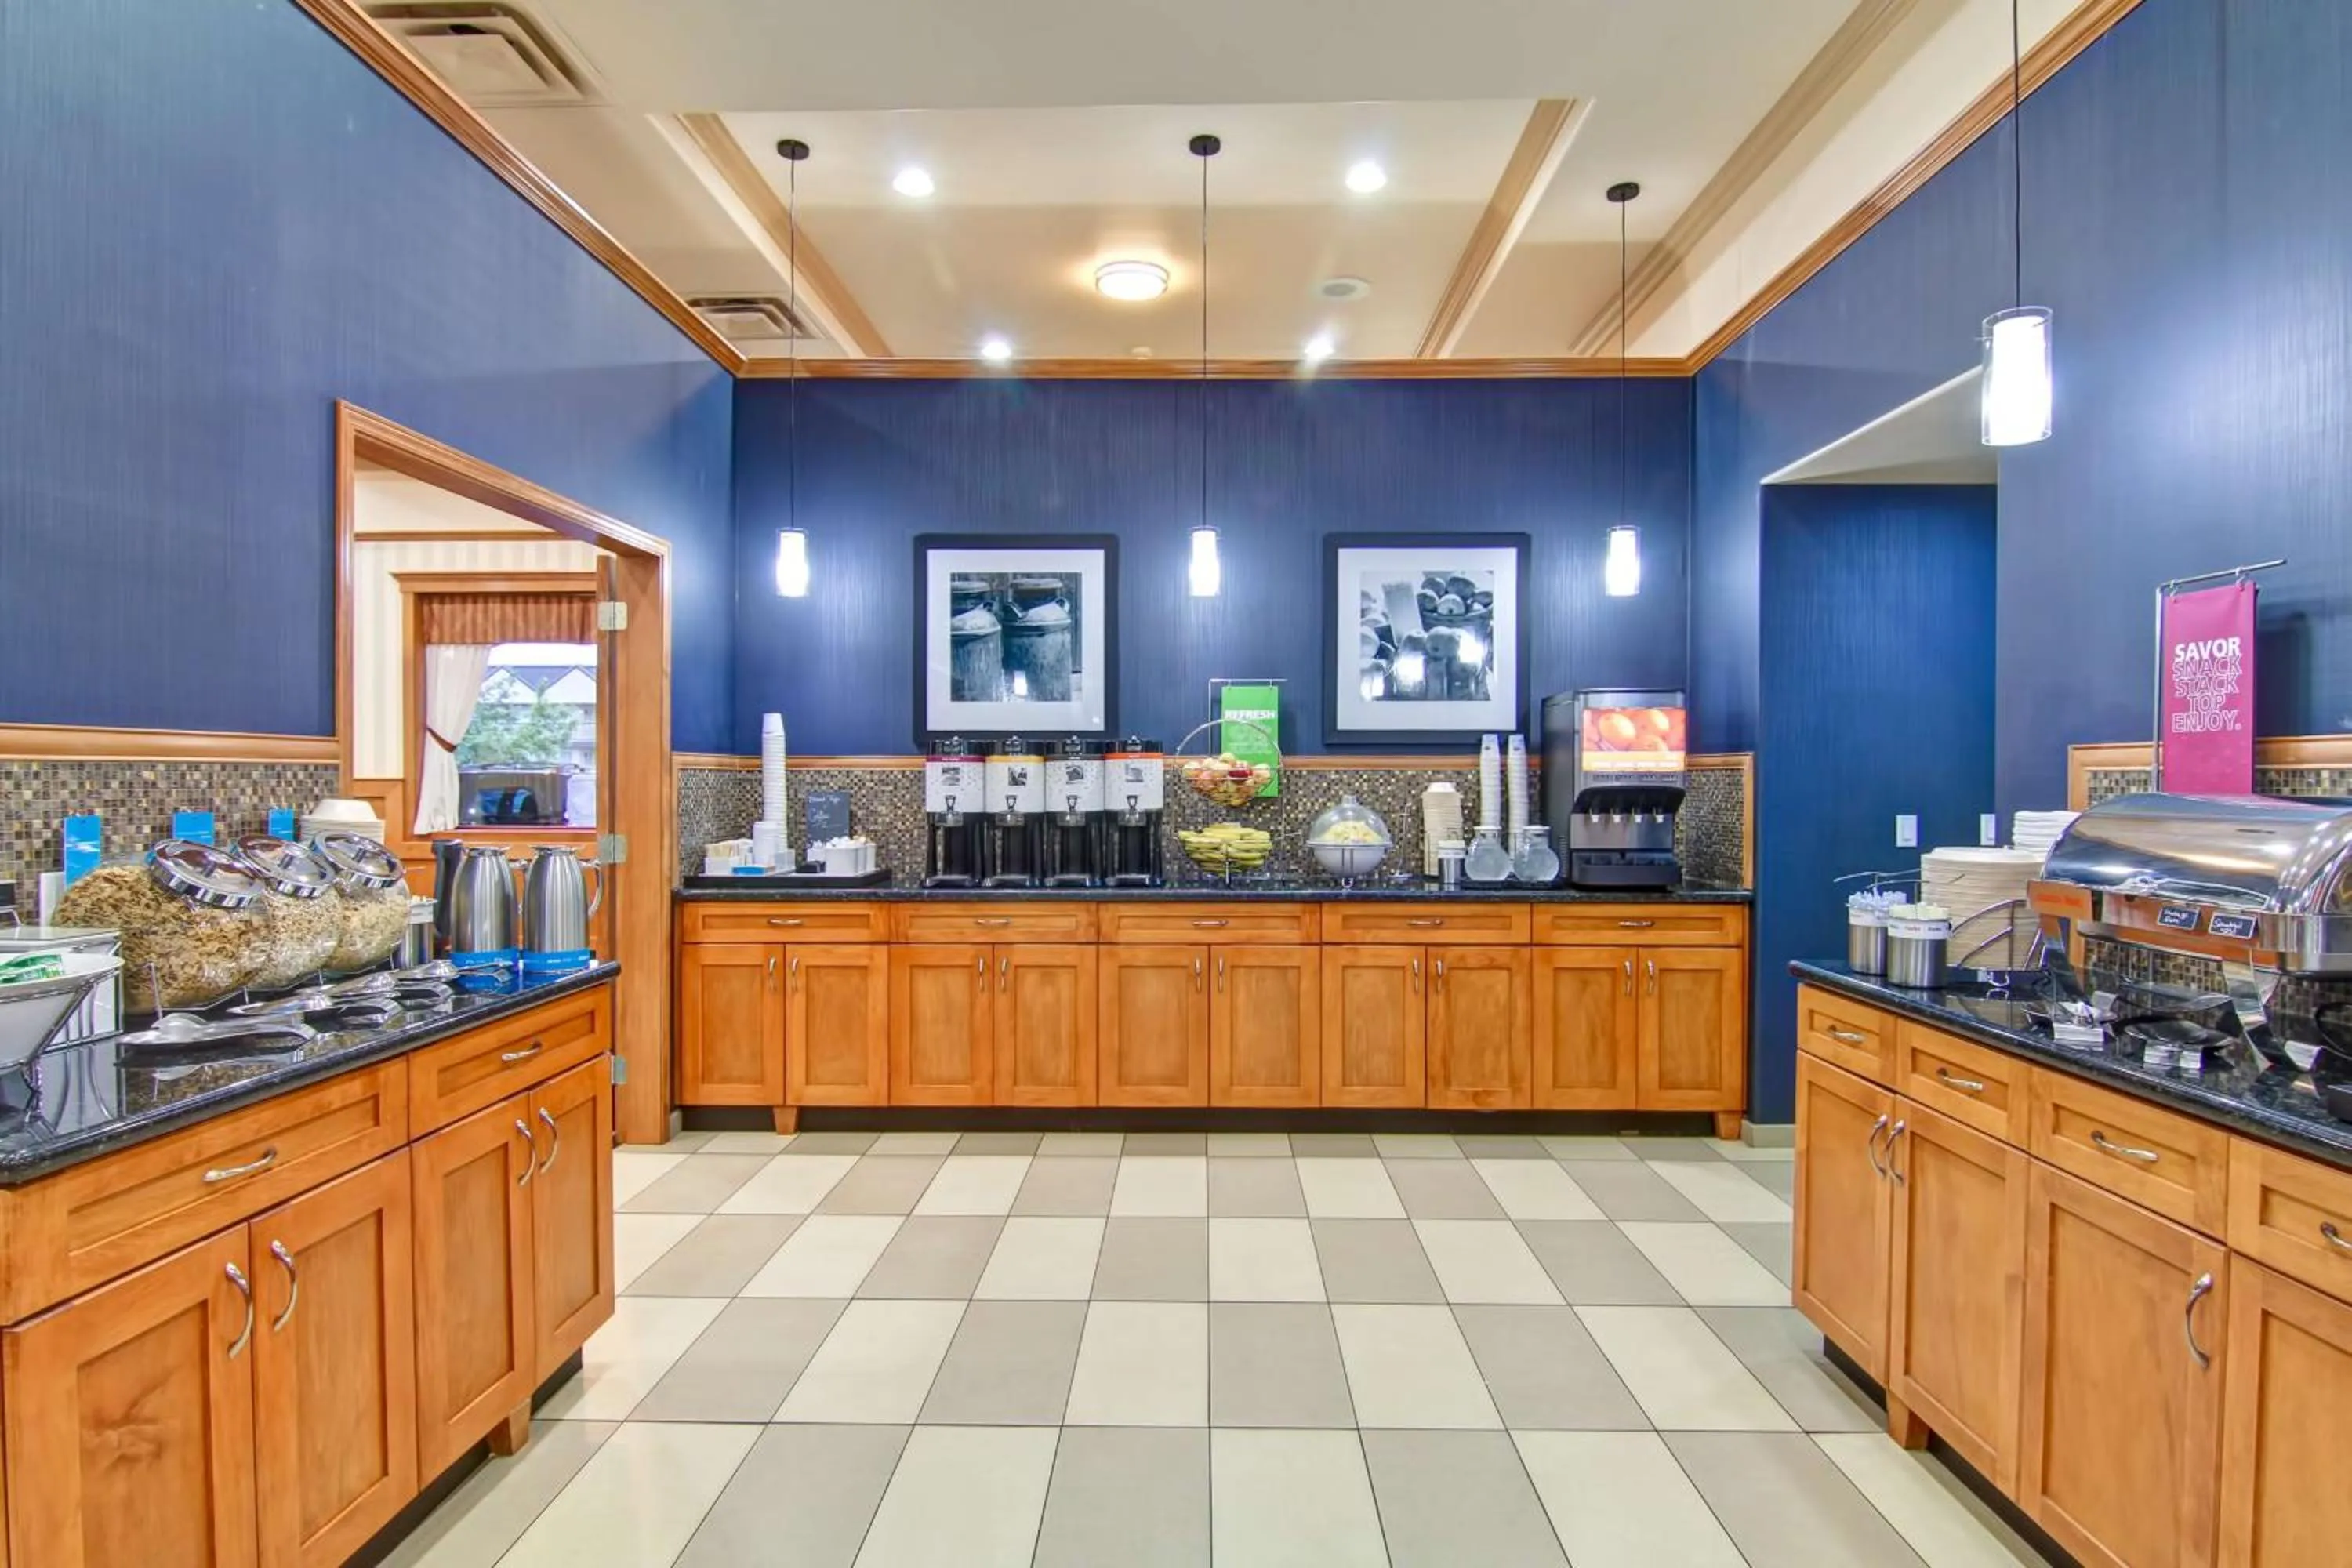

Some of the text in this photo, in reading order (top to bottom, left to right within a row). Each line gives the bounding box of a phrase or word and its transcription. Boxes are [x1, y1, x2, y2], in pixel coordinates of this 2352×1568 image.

[2175, 637, 2241, 661] SAVOR
[2172, 655, 2243, 681] SNACK
[2176, 673, 2240, 698] STACK
[2187, 692, 2227, 714] TOP
[2171, 710, 2242, 733] ENJOY.
